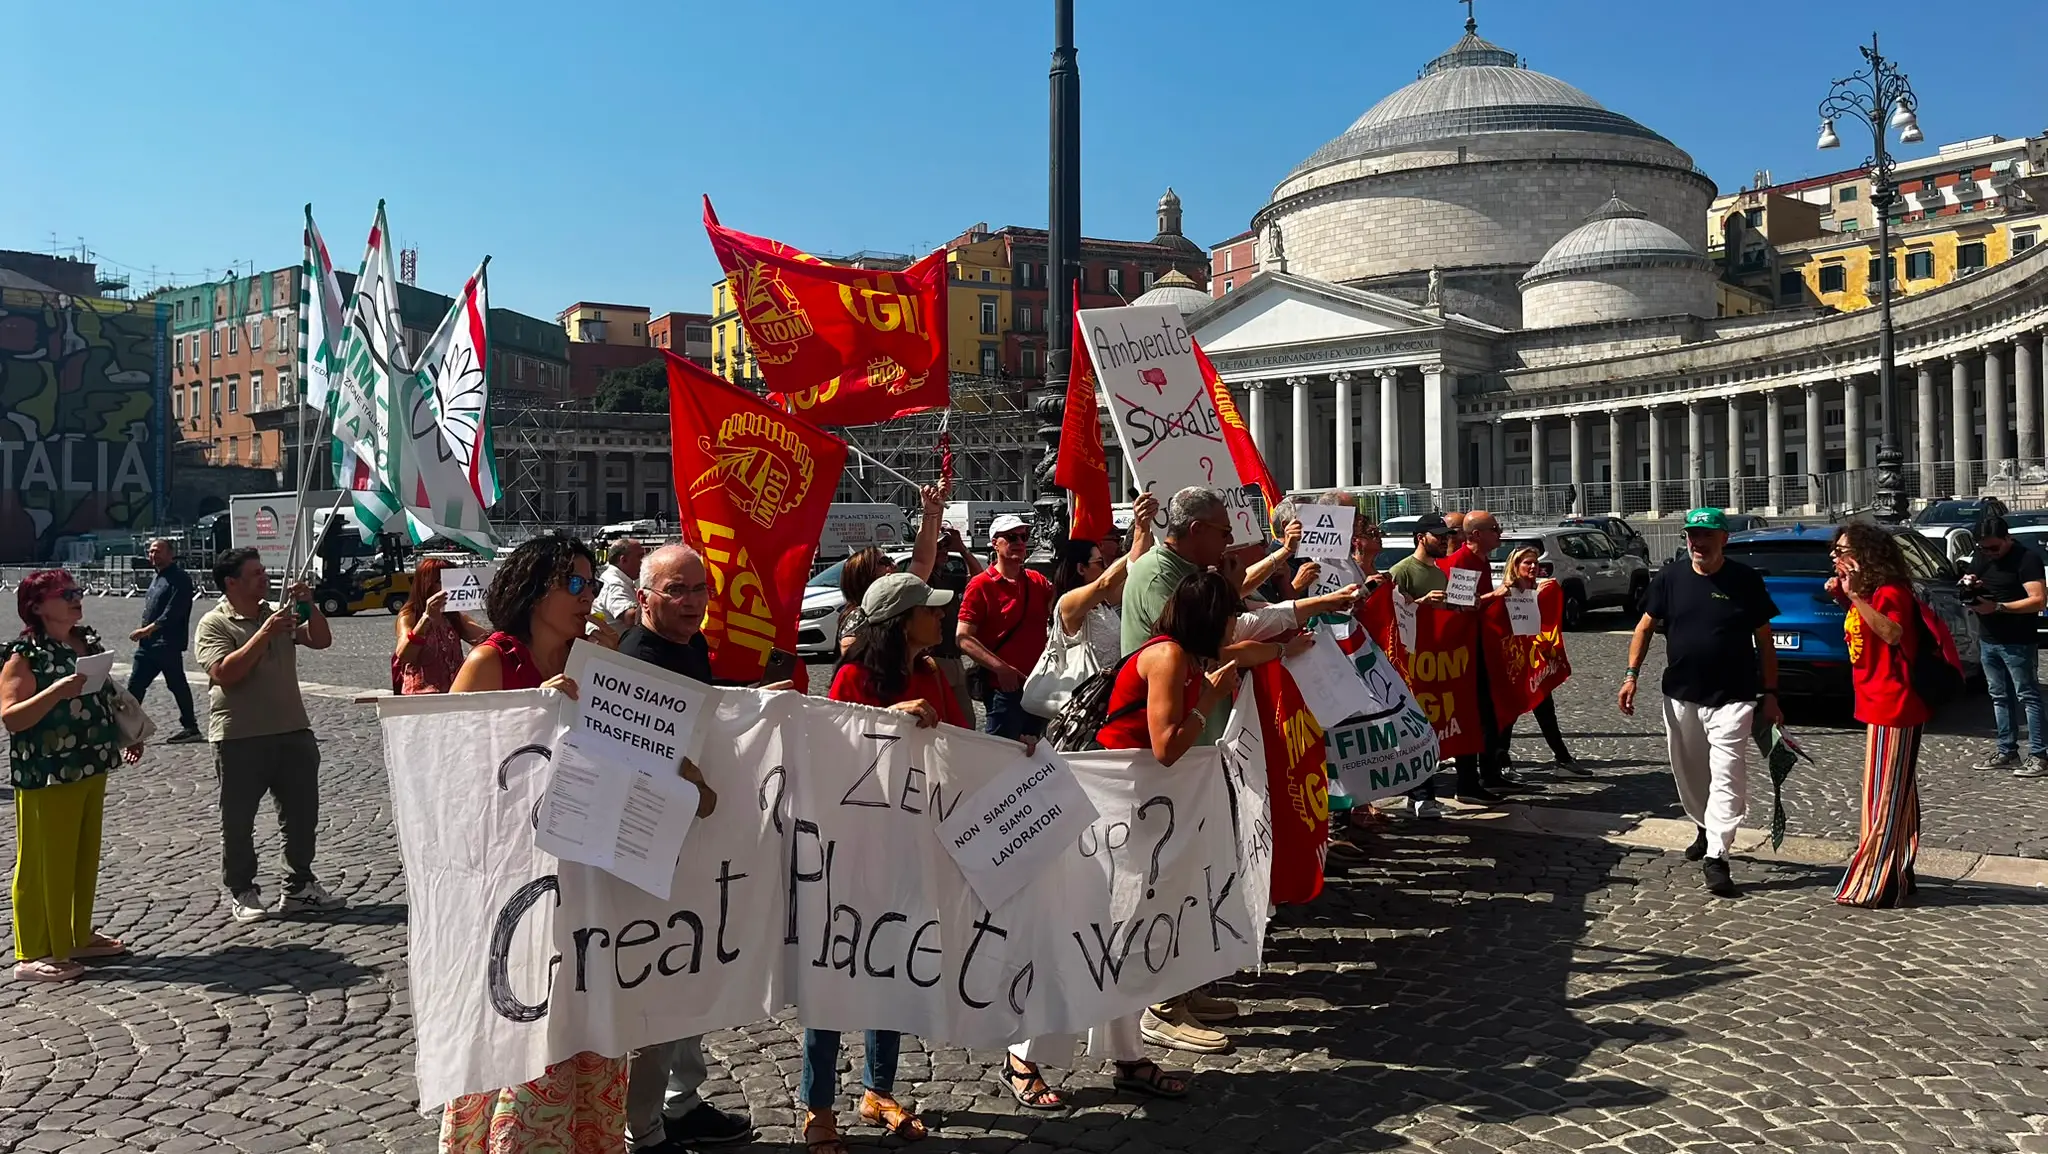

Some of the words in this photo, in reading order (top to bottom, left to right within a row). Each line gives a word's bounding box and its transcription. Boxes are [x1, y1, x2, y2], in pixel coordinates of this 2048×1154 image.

[760, 317, 808, 342] FIOM
[1094, 316, 1192, 370] Ambiente
[1126, 399, 1220, 450] Sociale
[1301, 530, 1343, 546] ZENITA
[592, 672, 631, 697] NON
[633, 686, 687, 714] SIAMO
[583, 715, 676, 760] TRASFERIRE
[591, 696, 650, 728] PACCHI
[654, 718, 676, 737] DA
[954, 823, 981, 849] NON
[983, 793, 1018, 825] SIAMO
[1015, 762, 1056, 798] PACCHI
[999, 804, 1033, 836] SIAMO
[991, 804, 1063, 867] LAVORATORI
[488, 859, 749, 1024] Great
[785, 818, 942, 988] Place
